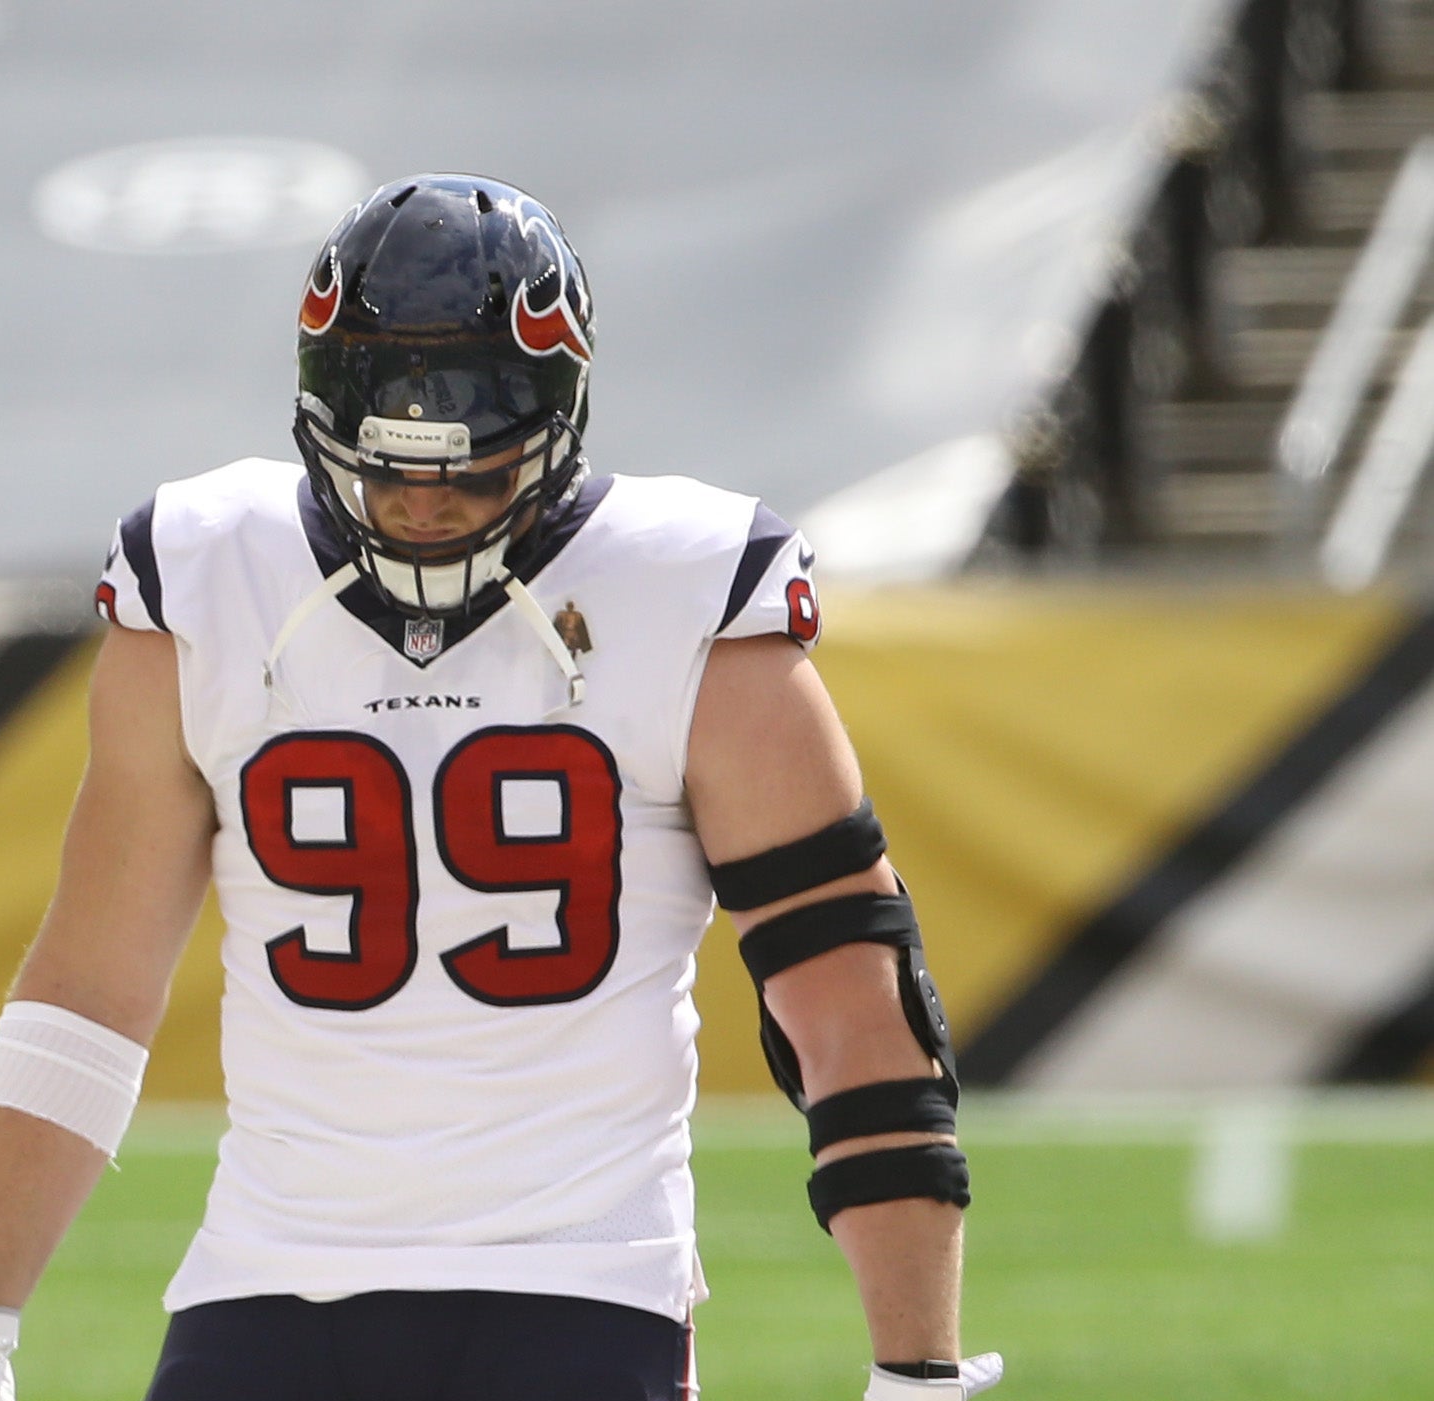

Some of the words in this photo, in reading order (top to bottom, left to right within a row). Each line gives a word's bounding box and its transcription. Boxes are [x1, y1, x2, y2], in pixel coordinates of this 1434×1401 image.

[385, 429, 442, 442] TEXANS
[362, 694, 482, 714] TEXANS
[239, 723, 624, 1012] 99
